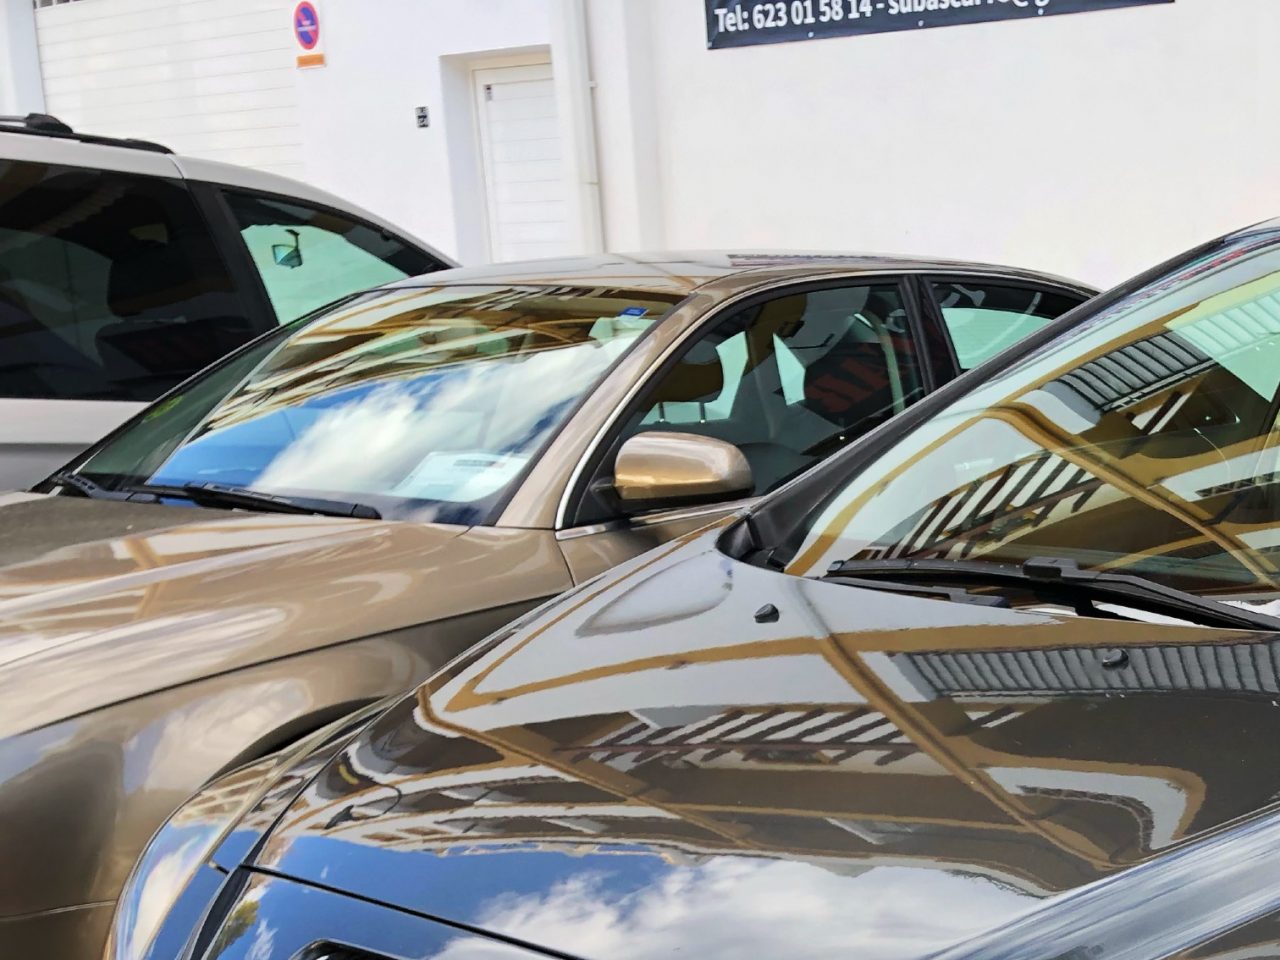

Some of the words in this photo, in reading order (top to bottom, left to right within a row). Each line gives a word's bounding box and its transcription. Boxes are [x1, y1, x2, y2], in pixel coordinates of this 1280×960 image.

[714, 5, 750, 32] Tel:
[752, 2, 788, 29] 623
[791, 0, 816, 25] 01
[819, 0, 844, 22] 58
[848, 0, 873, 19] 14
